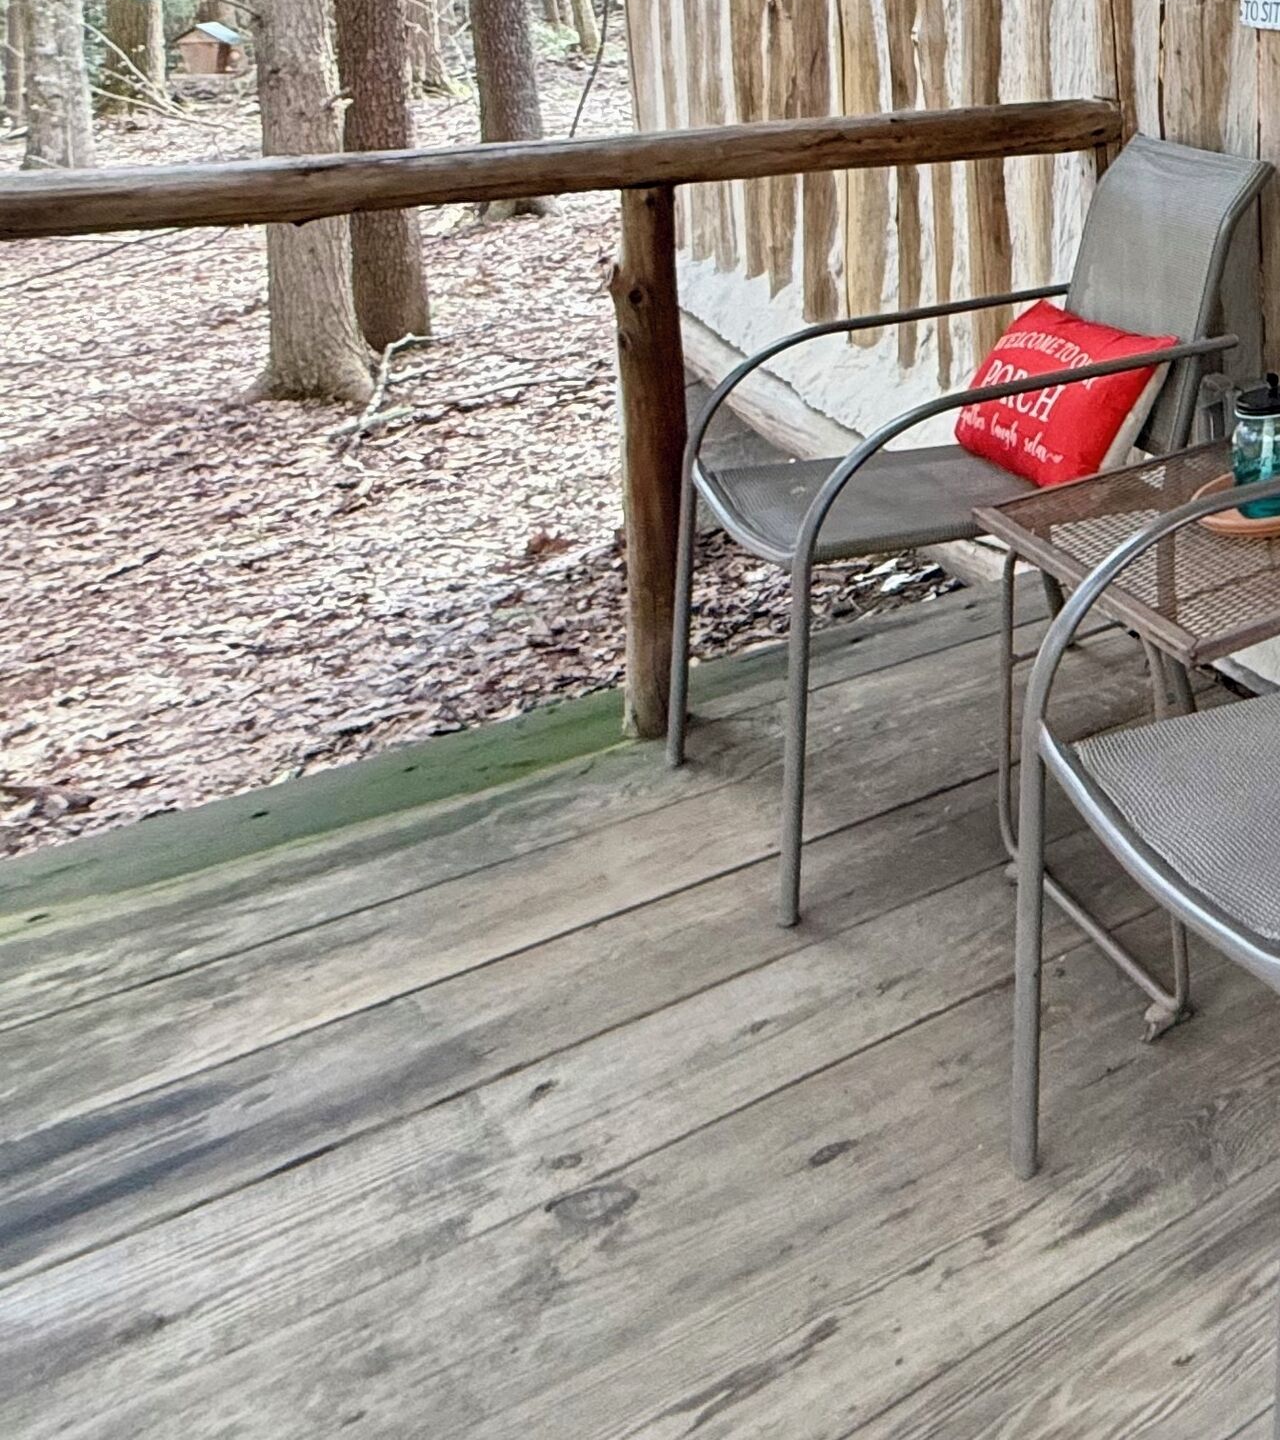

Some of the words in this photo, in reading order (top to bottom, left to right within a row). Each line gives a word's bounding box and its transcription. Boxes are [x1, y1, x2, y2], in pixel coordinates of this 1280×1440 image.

[1243, 0, 1259, 22] TO
[993, 331, 1066, 355] WELCOME
[1054, 342, 1081, 363] TO
